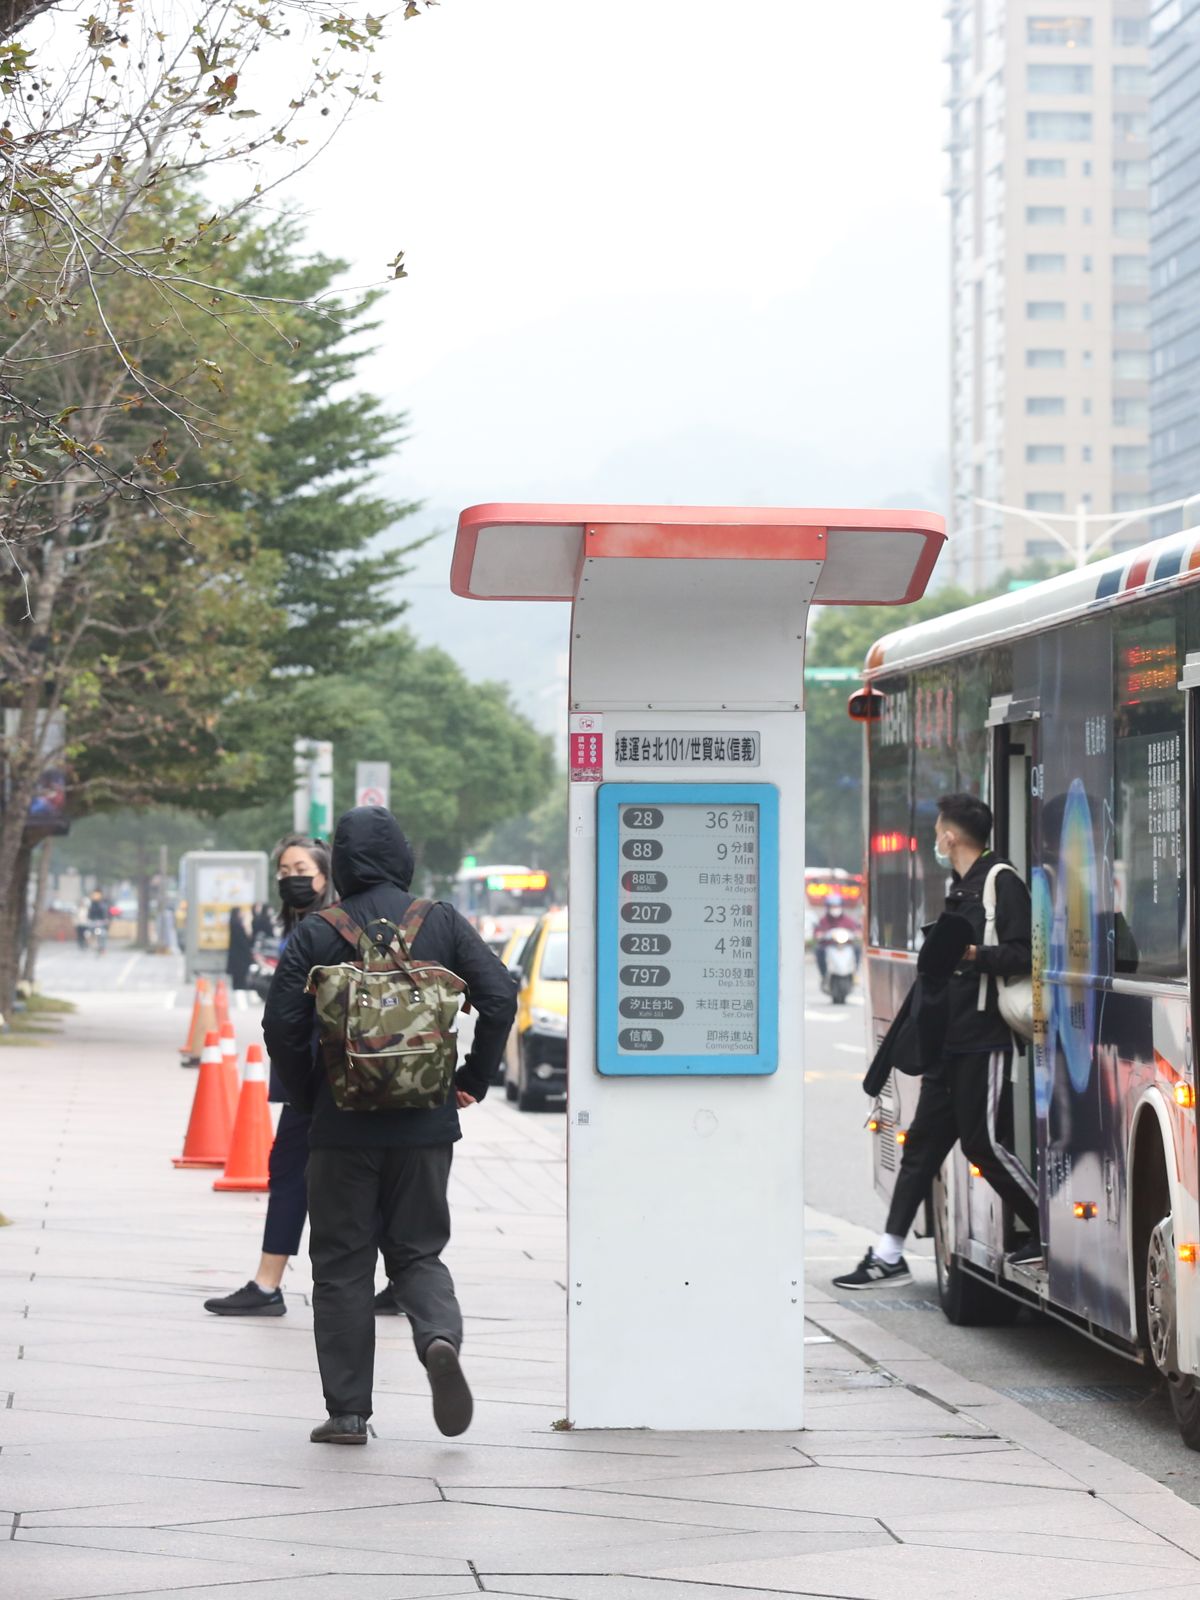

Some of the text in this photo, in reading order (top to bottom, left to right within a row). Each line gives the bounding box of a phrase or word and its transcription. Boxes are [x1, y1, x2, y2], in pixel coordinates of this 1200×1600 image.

[615, 736, 756, 762] 捷運台北101/世貿站(信義)
[633, 811, 653, 826] 28
[705, 810, 755, 829] 36 分鐘
[735, 823, 755, 834] Min
[632, 842, 652, 858] 88
[717, 842, 754, 861] 9 分鐘
[734, 855, 754, 865] Min
[632, 873, 657, 885] 88區
[699, 873, 756, 885] 目前未發車
[631, 905, 661, 920] 207
[704, 904, 753, 923] 23 分鐘
[733, 917, 753, 928] Min
[630, 937, 660, 952] 281
[714, 935, 753, 955] 4 分鐘
[732, 949, 752, 959] Min
[630, 968, 660, 984] 797
[702, 967, 755, 979] 15:30發車
[630, 998, 673, 1010] 汐止台北
[695, 999, 754, 1011] 末班車已過
[629, 1030, 653, 1042] 信義
[706, 1030, 753, 1042] 即將進站
